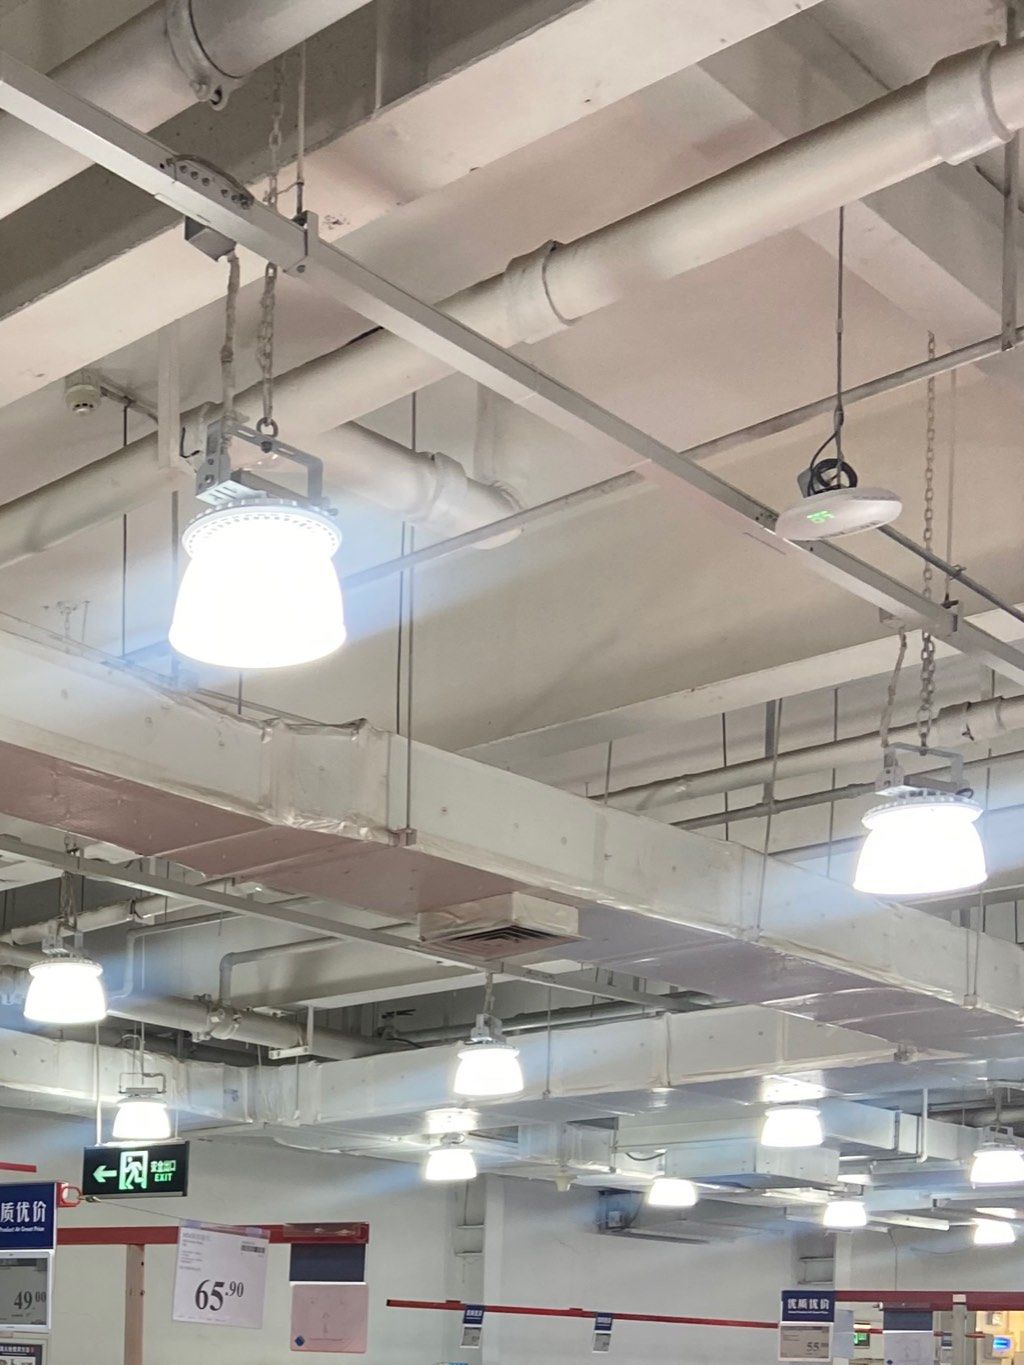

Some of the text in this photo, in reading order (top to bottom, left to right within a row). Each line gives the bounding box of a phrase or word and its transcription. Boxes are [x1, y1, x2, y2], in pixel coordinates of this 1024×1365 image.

[154, 1173, 172, 1181] EXIT
[195, 1279, 244, 1311] 65.90
[787, 1298, 829, 1309] 优质优价
